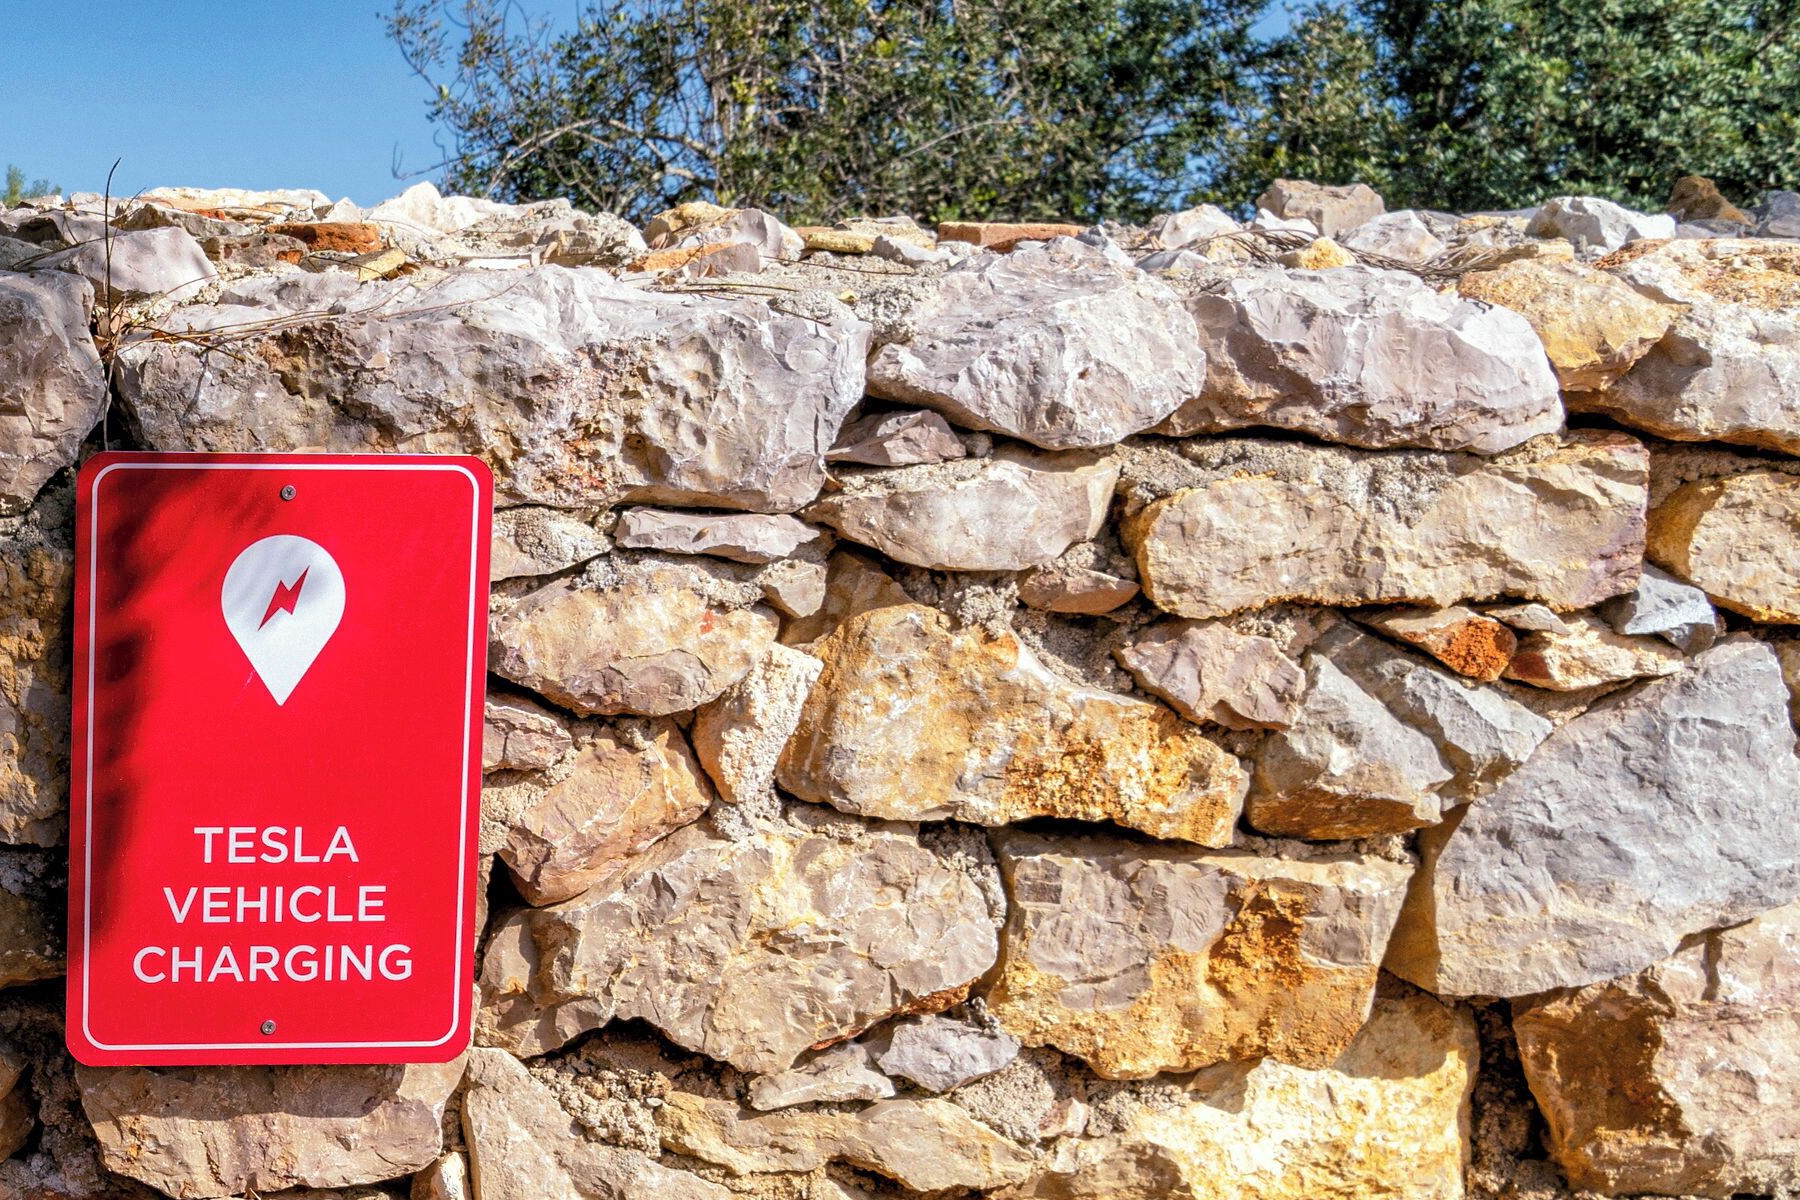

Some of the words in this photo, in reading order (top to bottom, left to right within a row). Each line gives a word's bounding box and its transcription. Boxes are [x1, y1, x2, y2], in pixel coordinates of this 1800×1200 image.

[193, 825, 360, 864] TESLA
[163, 885, 387, 924] VEHICLE
[133, 943, 413, 984] CHARGING
